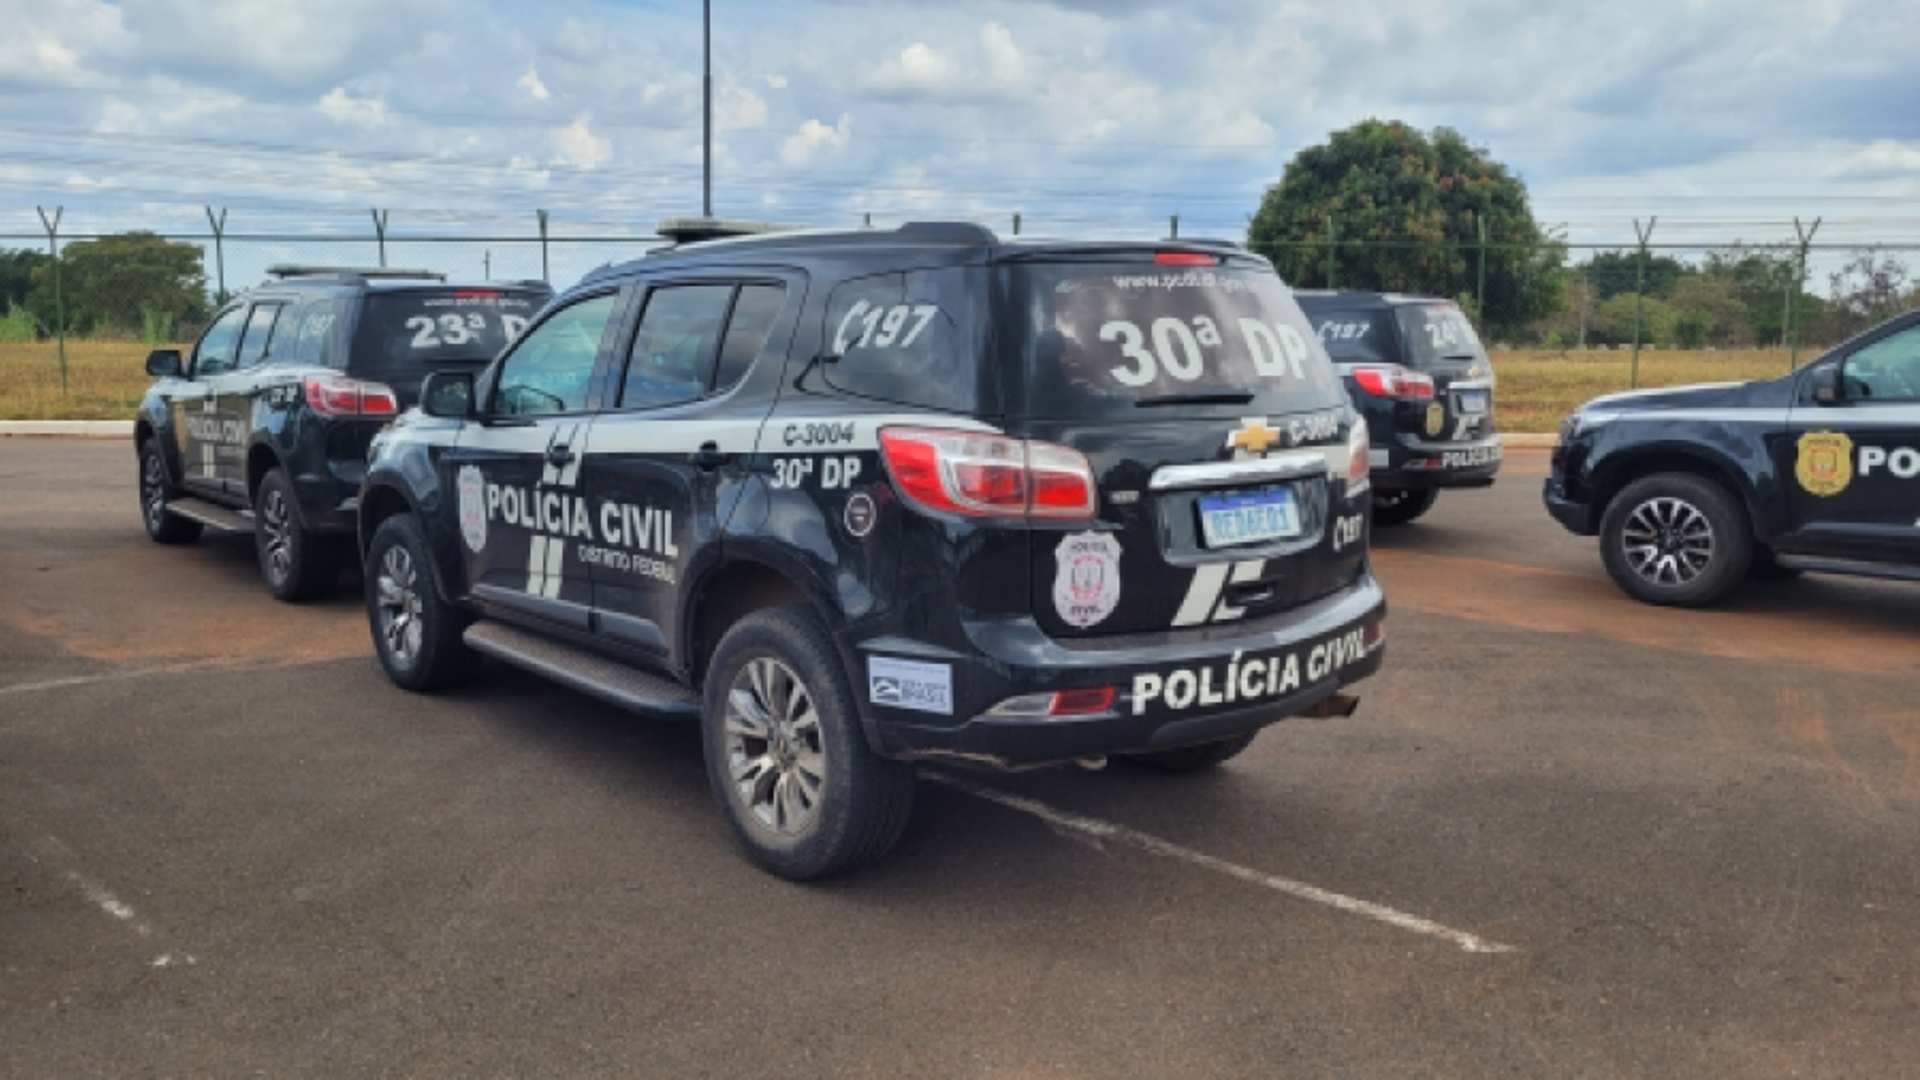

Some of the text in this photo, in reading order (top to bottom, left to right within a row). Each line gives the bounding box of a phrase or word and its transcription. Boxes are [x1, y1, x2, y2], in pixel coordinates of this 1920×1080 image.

[856, 304, 939, 349] 197
[1099, 314, 1308, 387] 30ª DP
[783, 421, 856, 446] C-3004
[820, 458, 863, 489] DP
[486, 481, 679, 558] POLÍCIA CIVIL
[1131, 626, 1366, 716] POLÍCIA CIVIL
